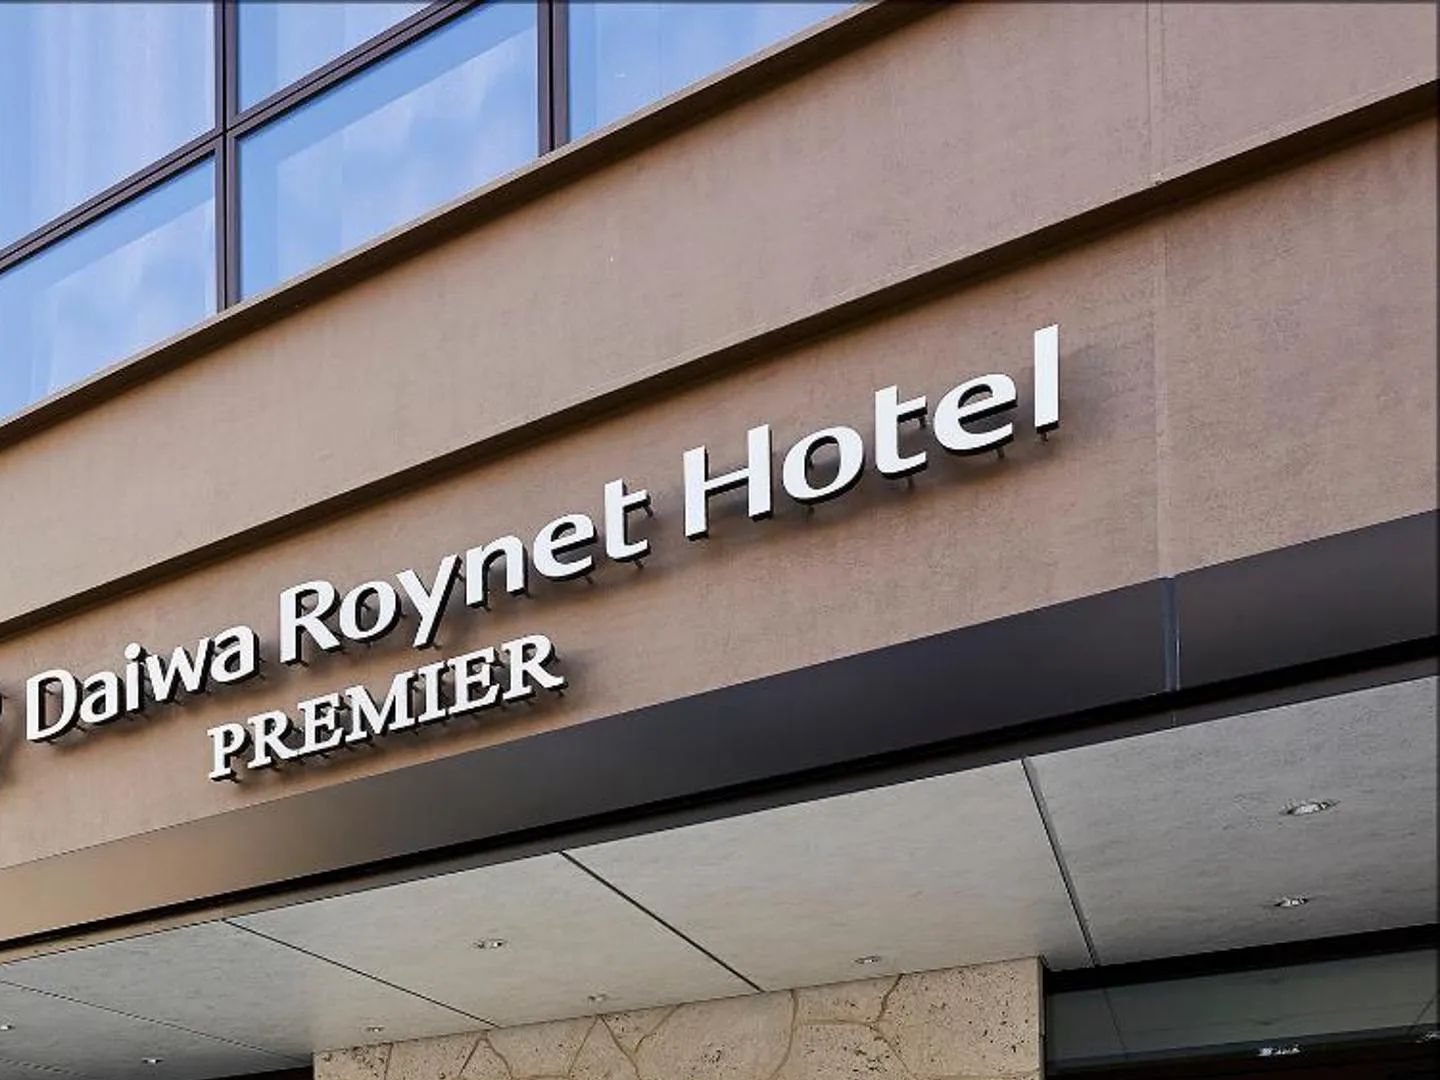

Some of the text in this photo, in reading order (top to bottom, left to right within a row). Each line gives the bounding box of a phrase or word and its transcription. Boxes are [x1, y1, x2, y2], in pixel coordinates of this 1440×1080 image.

[25, 626, 256, 743] Daiwa
[278, 481, 652, 665] Roynet
[683, 324, 1062, 542] Hotel
[208, 634, 565, 781] PREMIER
